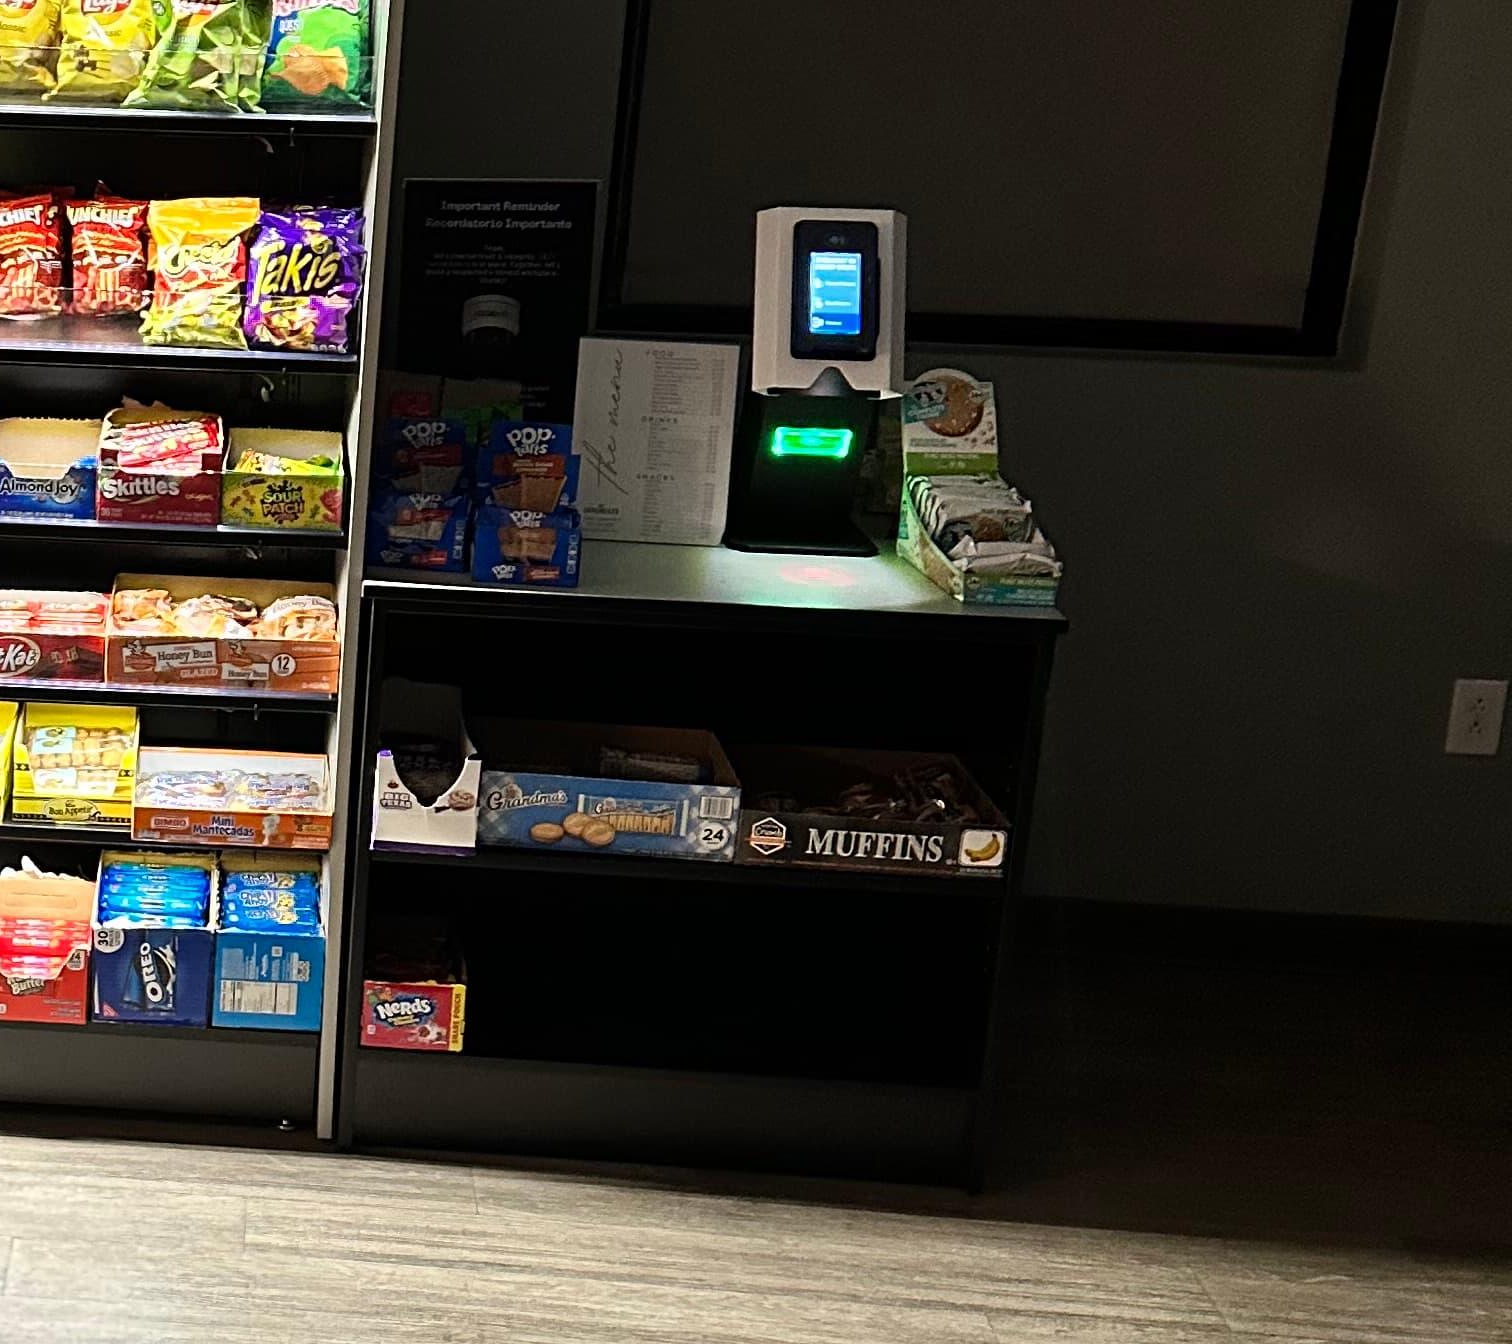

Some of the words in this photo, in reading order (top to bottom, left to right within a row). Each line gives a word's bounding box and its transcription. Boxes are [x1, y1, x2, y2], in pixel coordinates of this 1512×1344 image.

[251, 241, 341, 306] Takis
[54, 481, 79, 501] Joy
[102, 476, 181, 500] Skittles
[263, 490, 302, 503] SOUR
[157, 649, 189, 663] Honey
[192, 649, 213, 659] Bun
[276, 656, 291, 671] 12
[488, 788, 569, 812] Grandma's
[192, 824, 255, 837] Mantecadas
[211, 816, 234, 827] Mini
[701, 827, 725, 843] 24
[804, 827, 946, 864] MUFFINS
[97, 931, 109, 948] 30
[140, 942, 164, 1003] OREO
[376, 997, 432, 1020] Nerds
